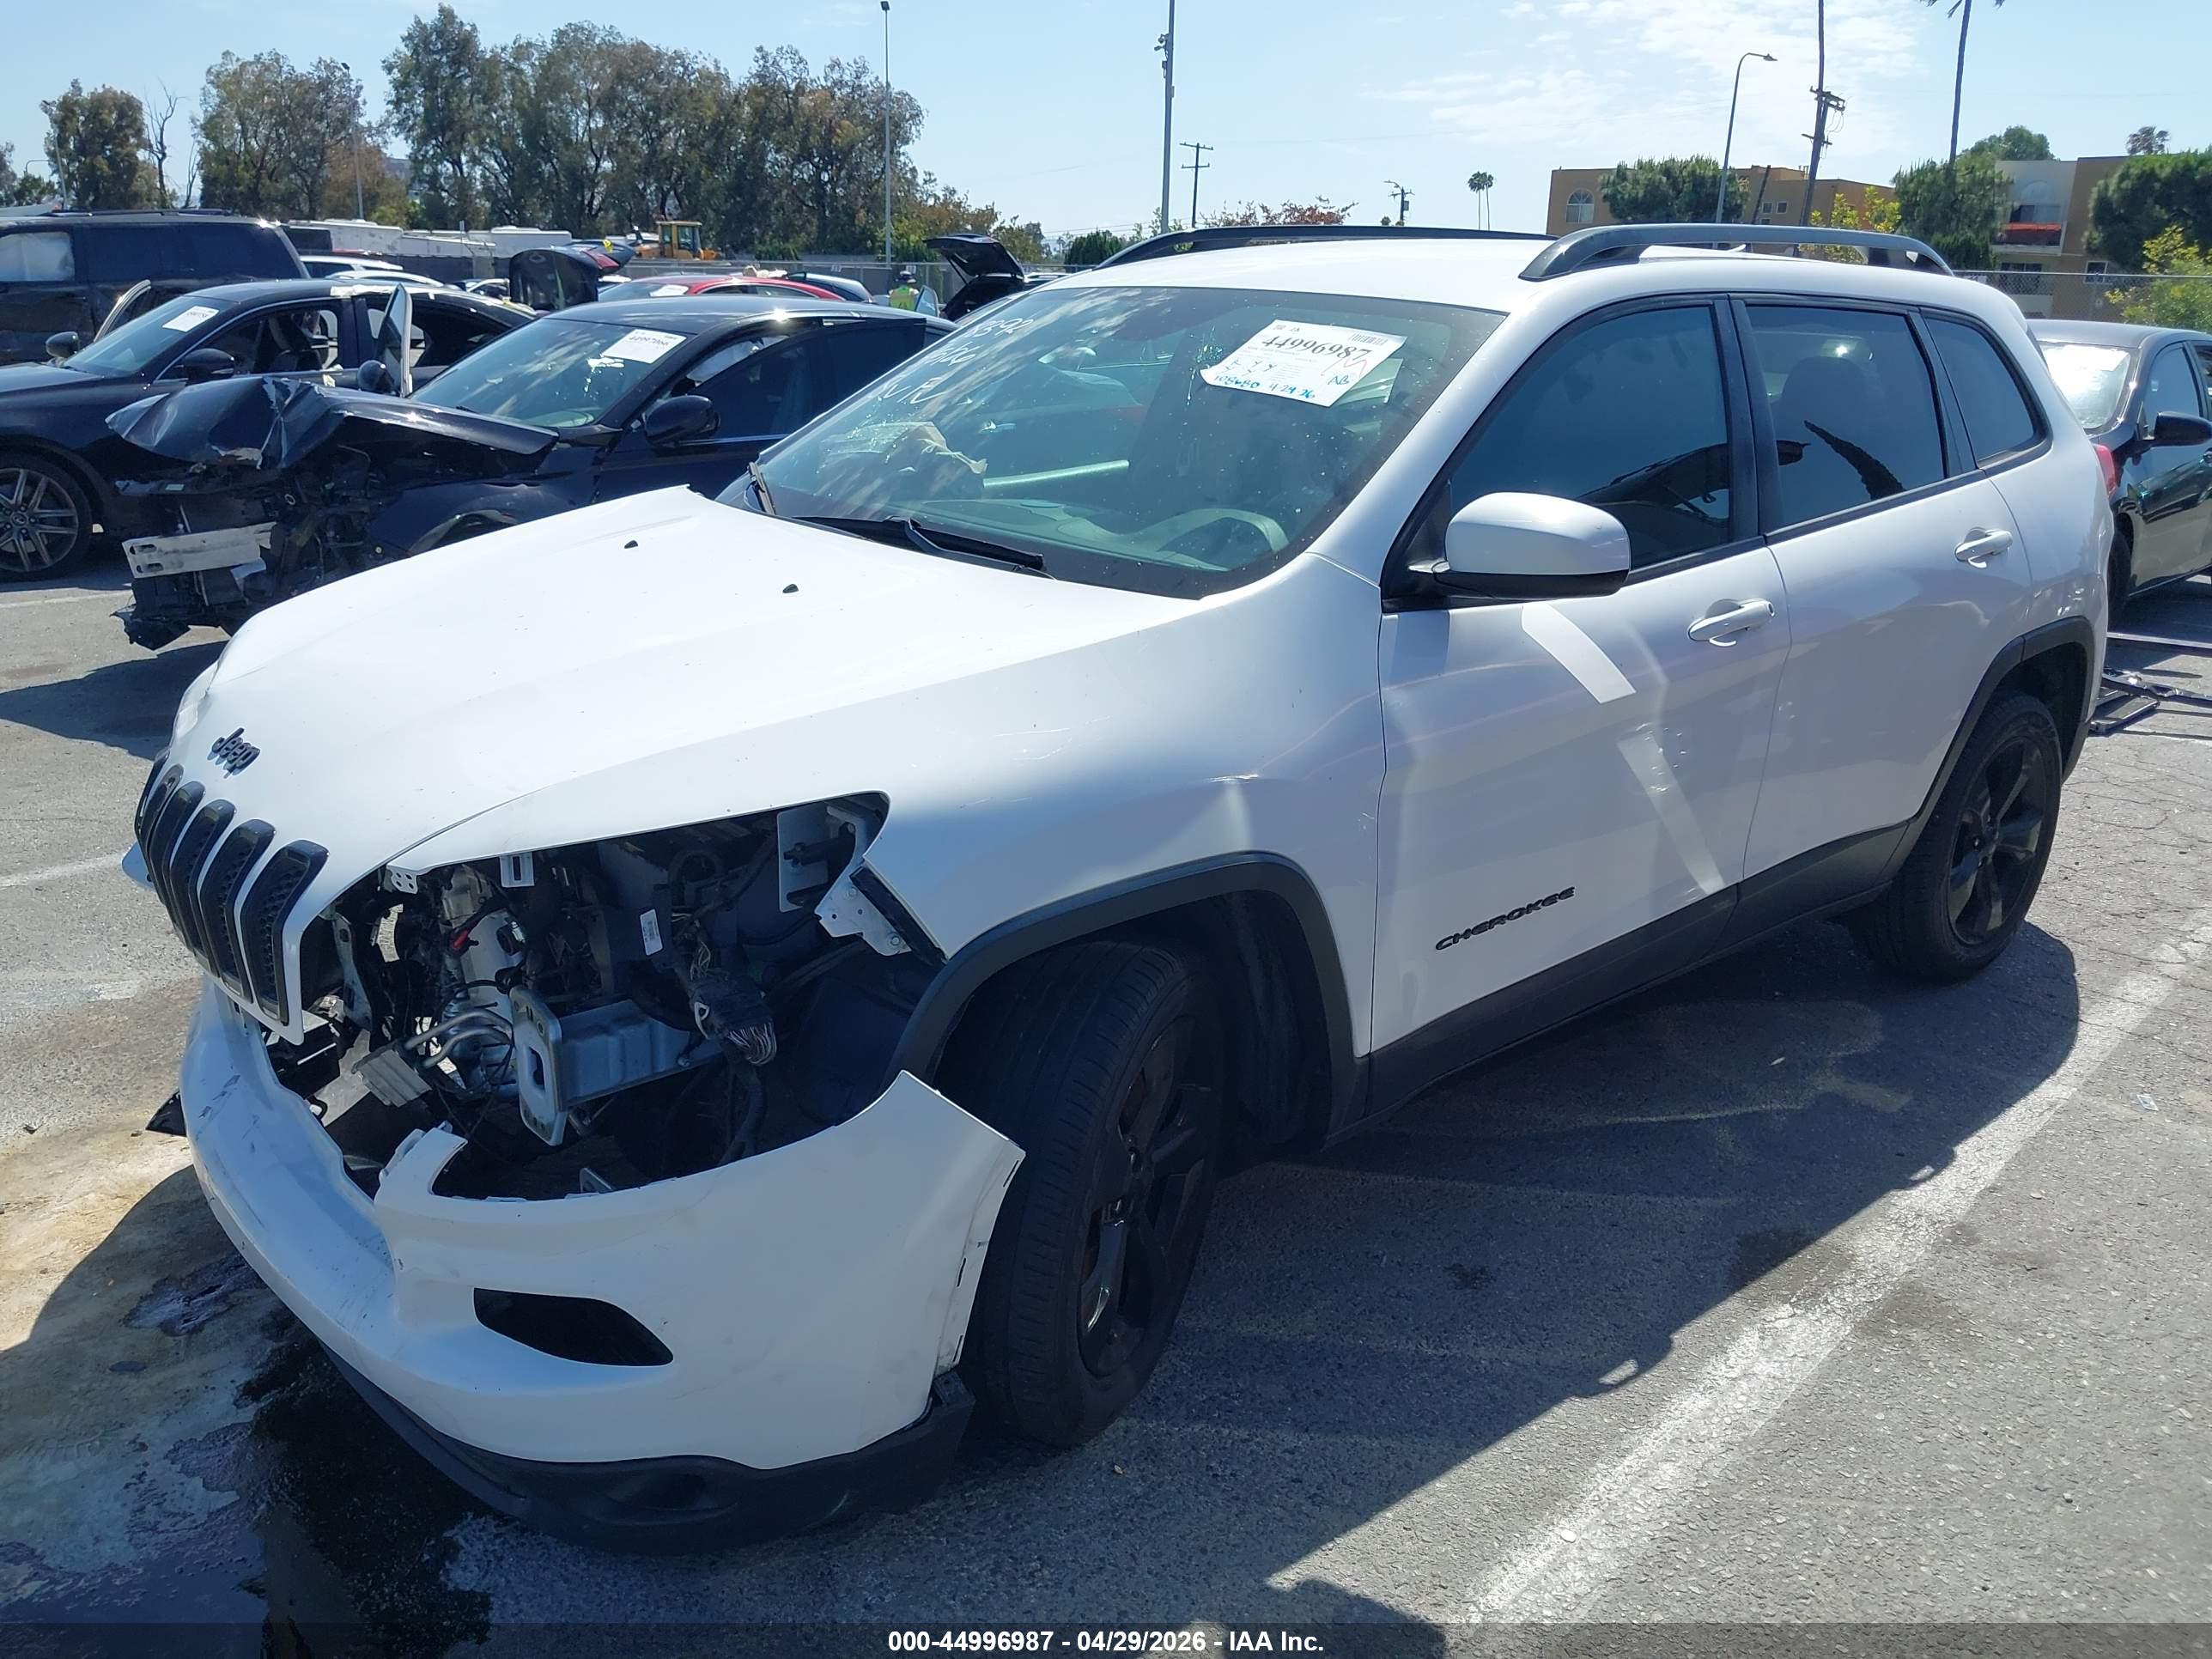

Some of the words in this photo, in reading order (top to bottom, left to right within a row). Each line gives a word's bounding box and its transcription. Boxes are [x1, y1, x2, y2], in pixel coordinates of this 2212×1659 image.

[1262, 336, 1373, 361] 44996987
[207, 728, 261, 779] Jeep
[1436, 886, 1576, 950] CHEROKEE
